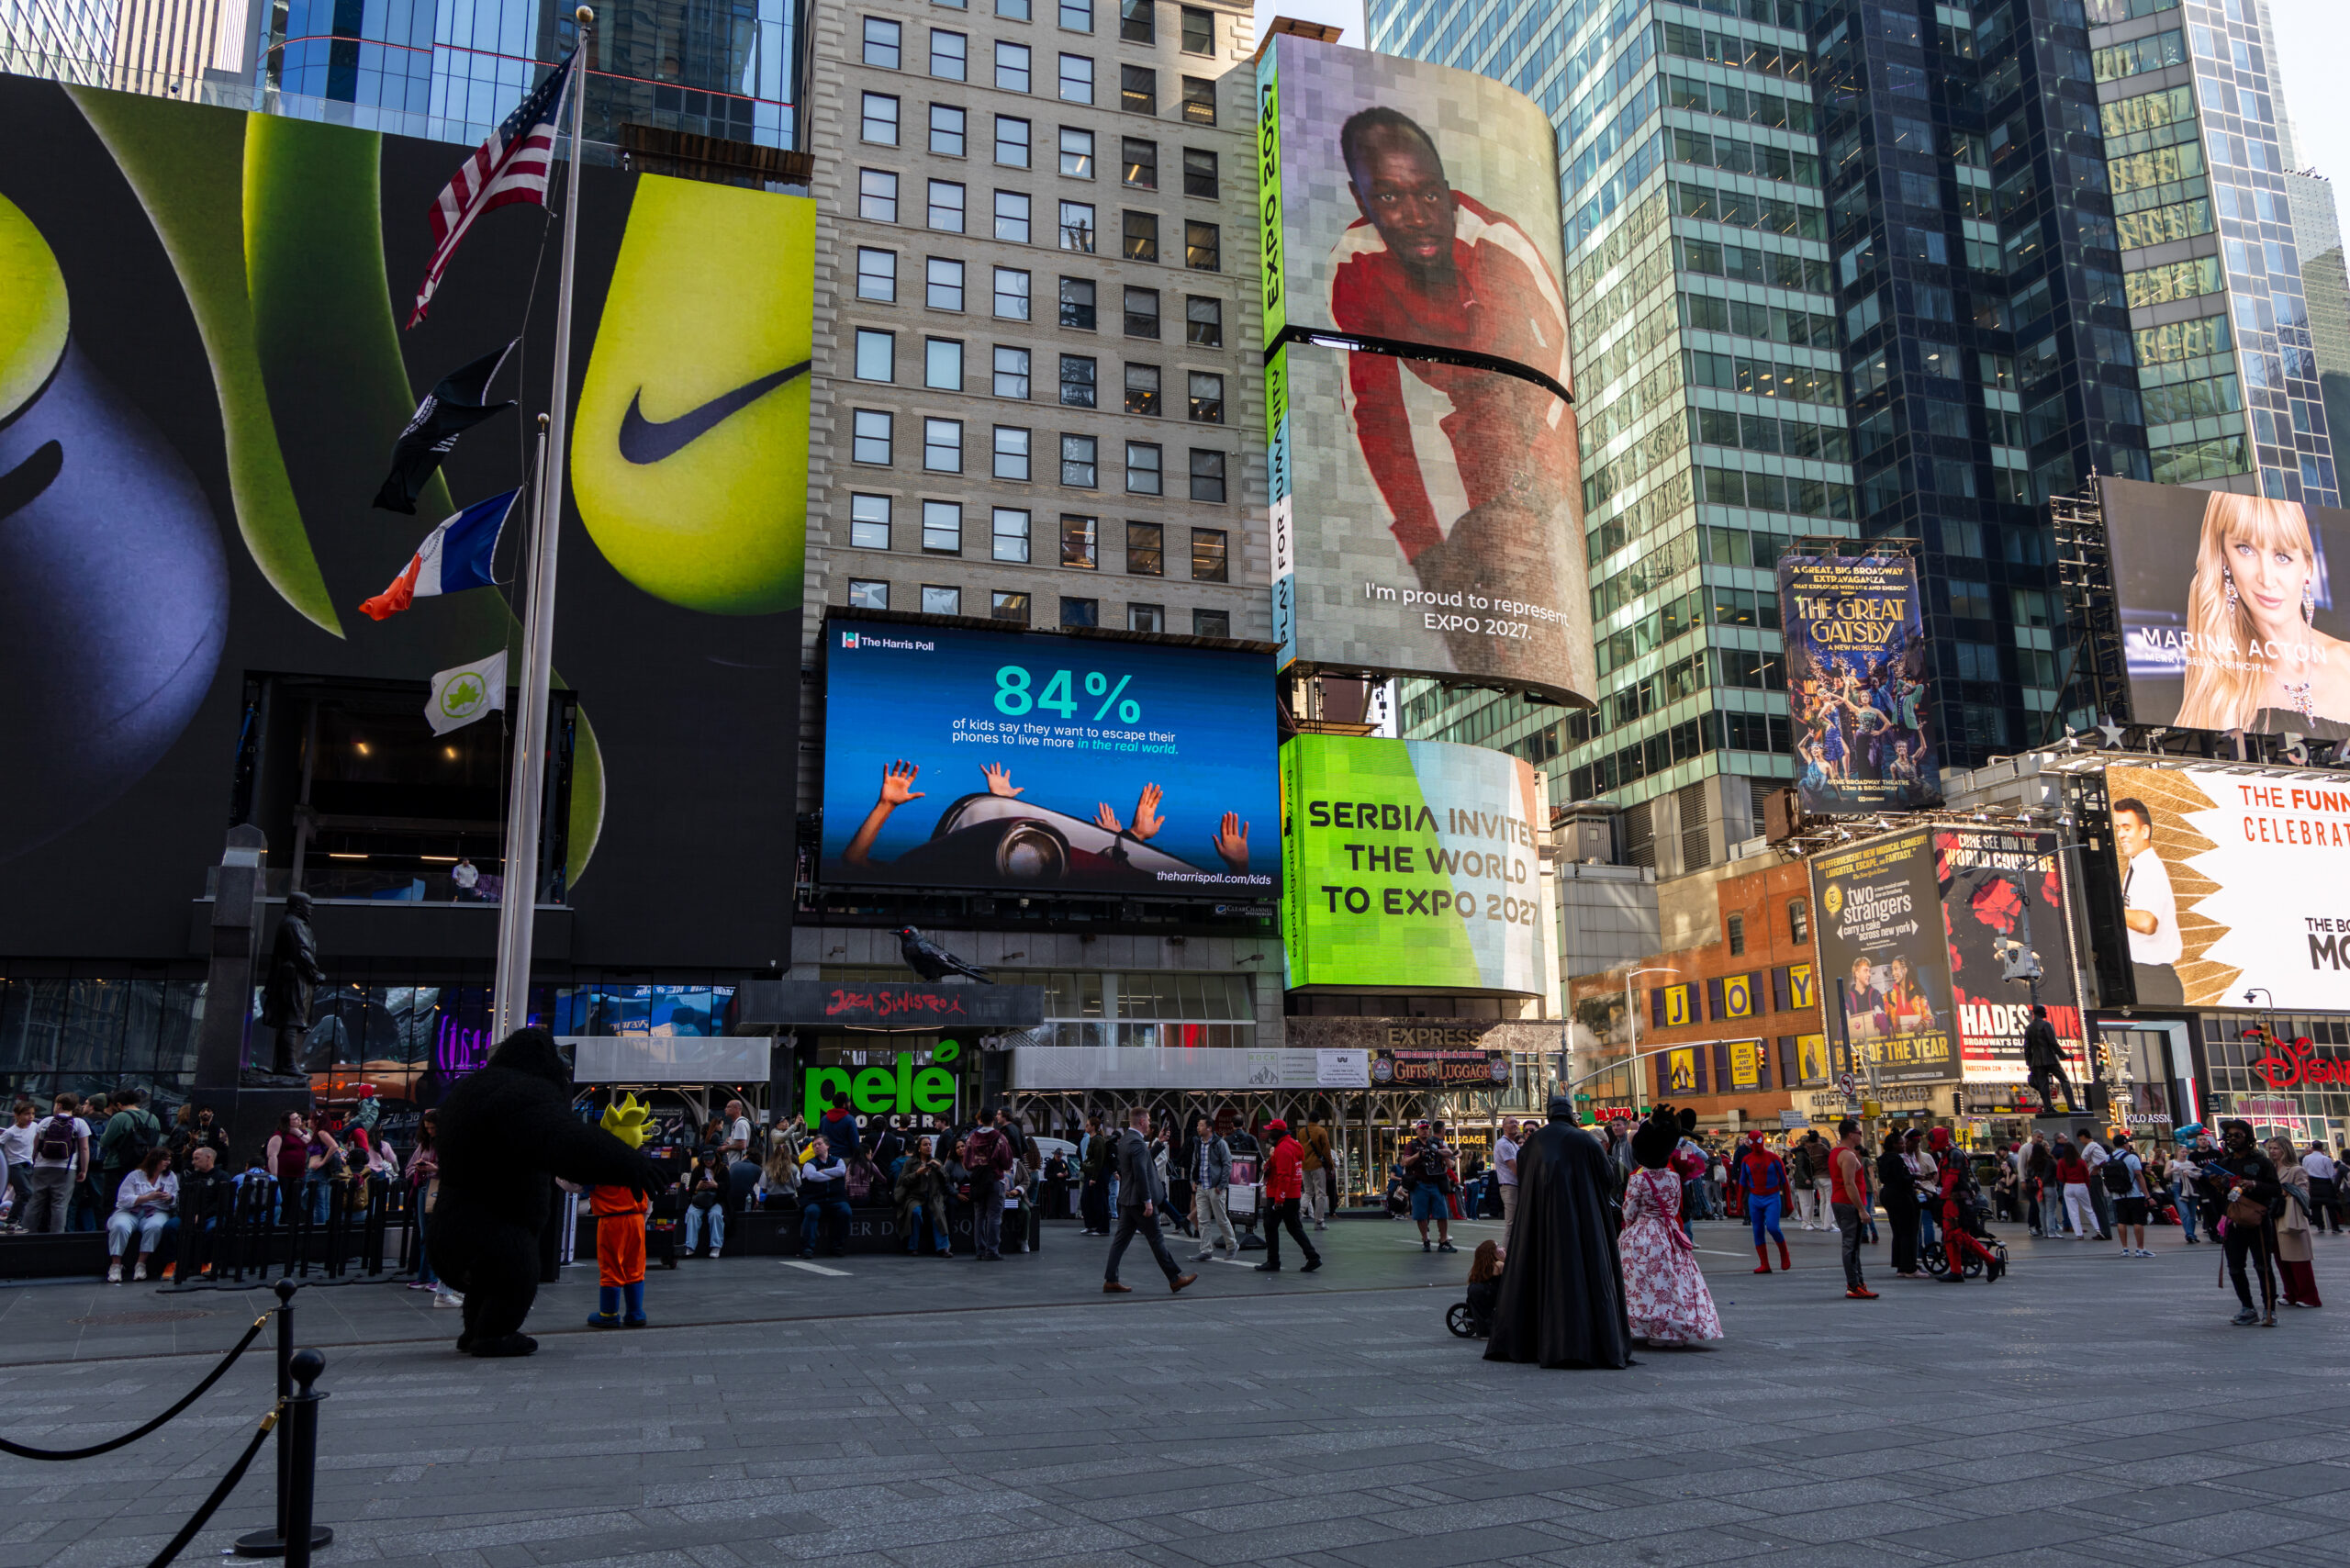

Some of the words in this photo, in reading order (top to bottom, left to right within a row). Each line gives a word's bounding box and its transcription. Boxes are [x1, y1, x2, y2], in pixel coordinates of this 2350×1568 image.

[1261, 84, 1274, 186] 2027
[1265, 194, 1280, 311] EXPO
[1272, 369, 1283, 508] HUMANITY
[1278, 517, 1286, 570] FOR
[1801, 566, 1833, 575] GREAT,
[1835, 566, 1852, 575] BIG
[1853, 567, 1904, 576] BROADWAY
[1813, 575, 1886, 584] EXTRAVAGANZA
[1279, 578, 1288, 644] PLAY
[1365, 582, 1396, 601] I'm
[1403, 588, 1462, 607] proud
[1468, 593, 1488, 610] to
[1494, 598, 1569, 627] represent
[1798, 597, 1833, 620] THE
[1837, 598, 1906, 621] GREAT
[1424, 612, 1480, 633] EXPO
[1484, 619, 1532, 640] 2027.
[1811, 621, 1895, 644] GATSBY
[861, 636, 881, 647] The
[882, 638, 913, 650] Harris
[915, 641, 934, 651] Poll
[2141, 627, 2241, 656] MARINA
[2248, 638, 2327, 664] ACTON
[2144, 652, 2182, 665] MERRY
[2186, 655, 2216, 669] BELLE
[2219, 660, 2276, 674] PRINCIPAL
[993, 665, 1141, 724] 84%
[952, 718, 967, 730] of
[969, 719, 995, 732] kids
[999, 722, 1020, 735] say
[1024, 722, 1050, 737] they
[1054, 725, 1084, 737] want
[1087, 727, 1099, 738] to
[1102, 729, 1146, 743] escape
[1148, 731, 1176, 743] their
[952, 730, 999, 745] phones
[1002, 734, 1014, 745] to
[1018, 734, 1040, 746] live
[1043, 736, 1075, 748] more
[1077, 737, 1089, 749] in
[1092, 739, 1112, 751] the
[1114, 741, 1139, 753] real
[1141, 742, 1180, 756] world.
[2238, 784, 2286, 809] THE
[1309, 800, 1440, 834] SERBIA
[1448, 807, 1538, 850] INVITES
[1825, 851, 1863, 869] EFFERVESCENT
[1863, 847, 1875, 859] NEW
[1875, 840, 1901, 856] MUSICAL
[1900, 834, 1928, 850] COMEDY!
[1957, 833, 1982, 849] COME
[1983, 834, 1999, 850] SEE
[2000, 835, 2020, 851] HOW
[2020, 836, 2038, 852] THE
[1285, 769, 1298, 958] expobelgrade227.org
[1343, 843, 1415, 874] THE
[1425, 847, 1527, 887] WORLD
[1825, 863, 1855, 879] LAUGHTER,
[1856, 857, 1879, 871] ESCAPE,
[1943, 847, 1991, 868] WORLD
[2038, 855, 2056, 873] BE
[1157, 870, 1271, 885] theharrispoll.com/kids
[1321, 885, 1371, 915] TO
[1383, 888, 1477, 919] EXPO
[1486, 893, 1539, 927] 2027
[1843, 894, 1912, 924] strangers
[1846, 885, 1874, 907] two
[1843, 924, 1860, 936] carry
[1860, 924, 1865, 932] a
[1865, 919, 1881, 932] cake
[1859, 929, 1880, 942] across
[1880, 926, 1895, 937] new
[1896, 921, 1911, 936] york
[2304, 917, 2333, 933] THE
[1673, 994, 1683, 1023] J
[1729, 984, 1748, 1014] O
[1791, 974, 1811, 1005] Y
[1959, 1003, 2082, 1038] HADESWN
[1388, 1027, 1483, 1047] EXPRESS
[1963, 1037, 2012, 1047] BROADWAY'S
[1459, 1050, 1471, 1058] NEW
[1471, 1050, 1485, 1058] YORK
[1836, 1045, 1864, 1069] BT
[1867, 1042, 1884, 1062] OF
[1885, 1039, 1912, 1061] THE
[1912, 1036, 1950, 1058] YEAR
[1393, 1059, 1428, 1080] GIFTS
[1437, 1059, 1491, 1081] LUGGAGE
[804, 1038, 960, 1130] pelé
[2124, 1114, 2146, 1123] POLO
[2148, 1114, 2173, 1124] ASSN.
